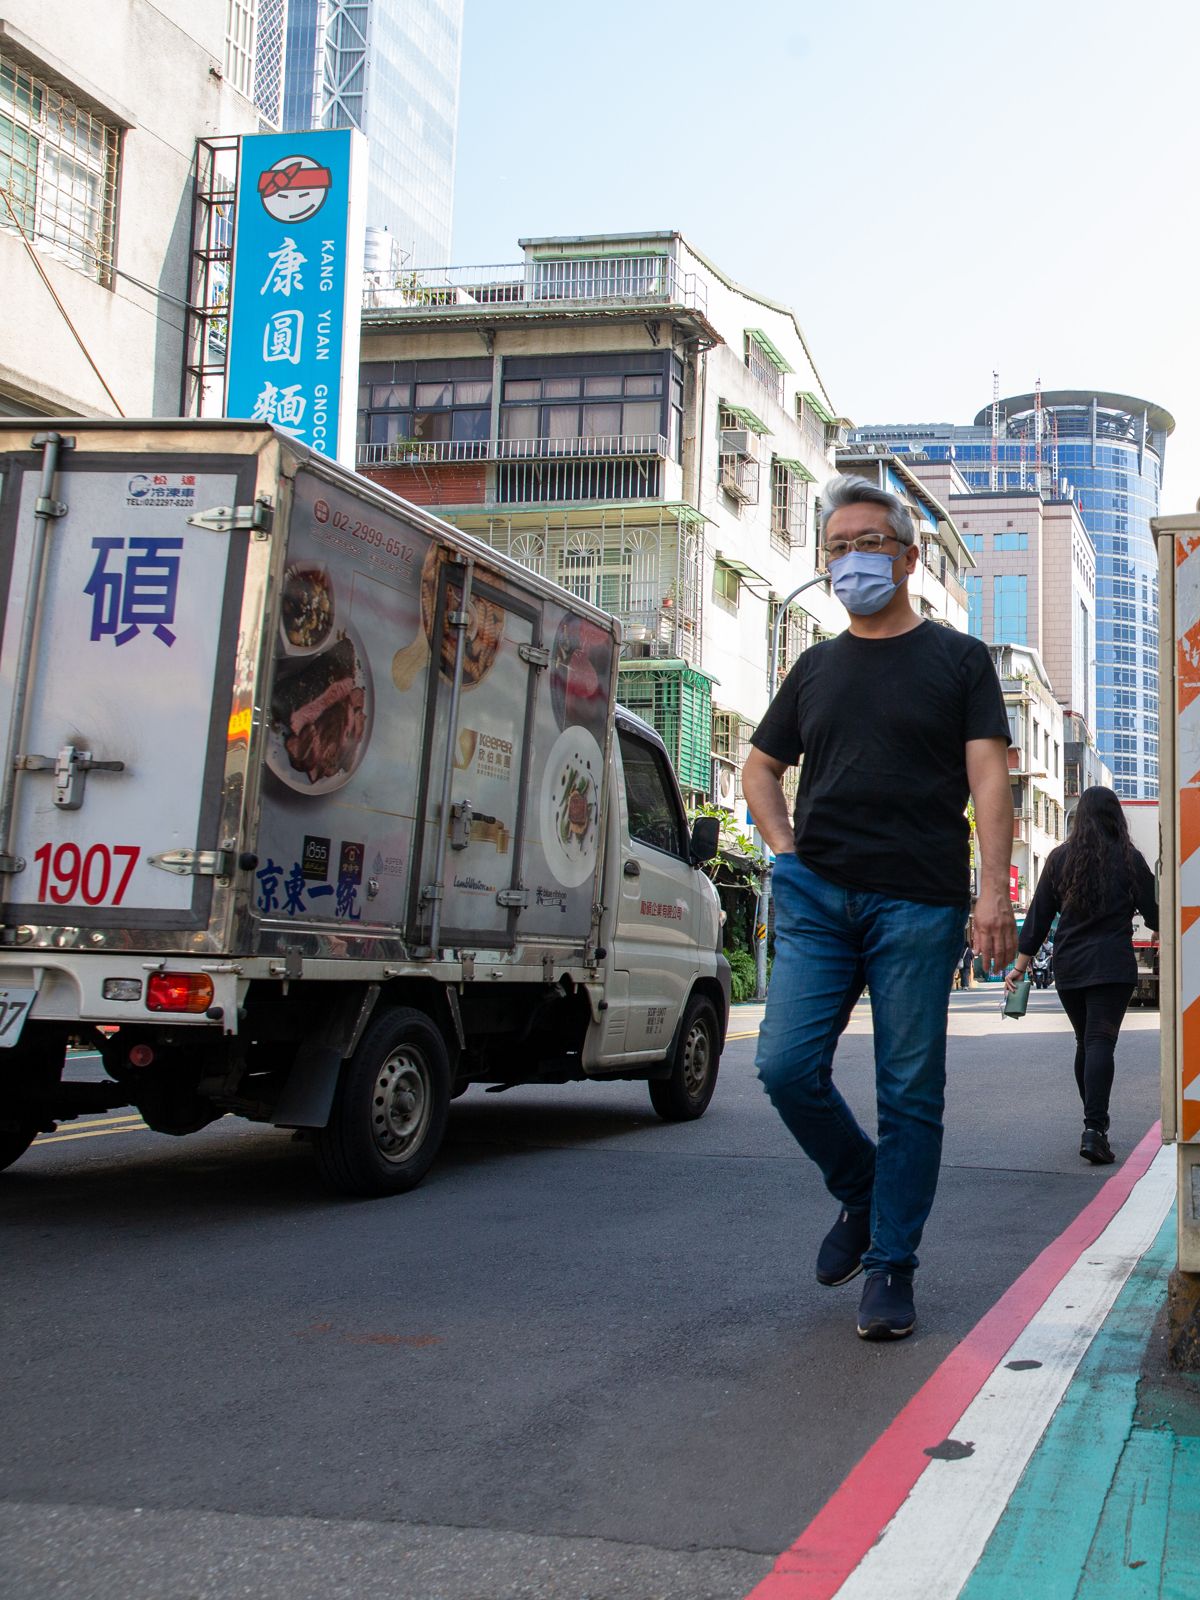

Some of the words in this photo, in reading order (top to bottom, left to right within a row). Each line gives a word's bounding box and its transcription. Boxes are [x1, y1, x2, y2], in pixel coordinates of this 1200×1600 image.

[320, 239, 335, 292] KANG
[316, 309, 333, 360] YUAN
[332, 511, 415, 563] 02-2999-6512
[83, 537, 184, 648] 碩
[34, 842, 141, 905] 1907
[305, 841, 328, 860] 1855
[256, 858, 361, 920] 京東一統
